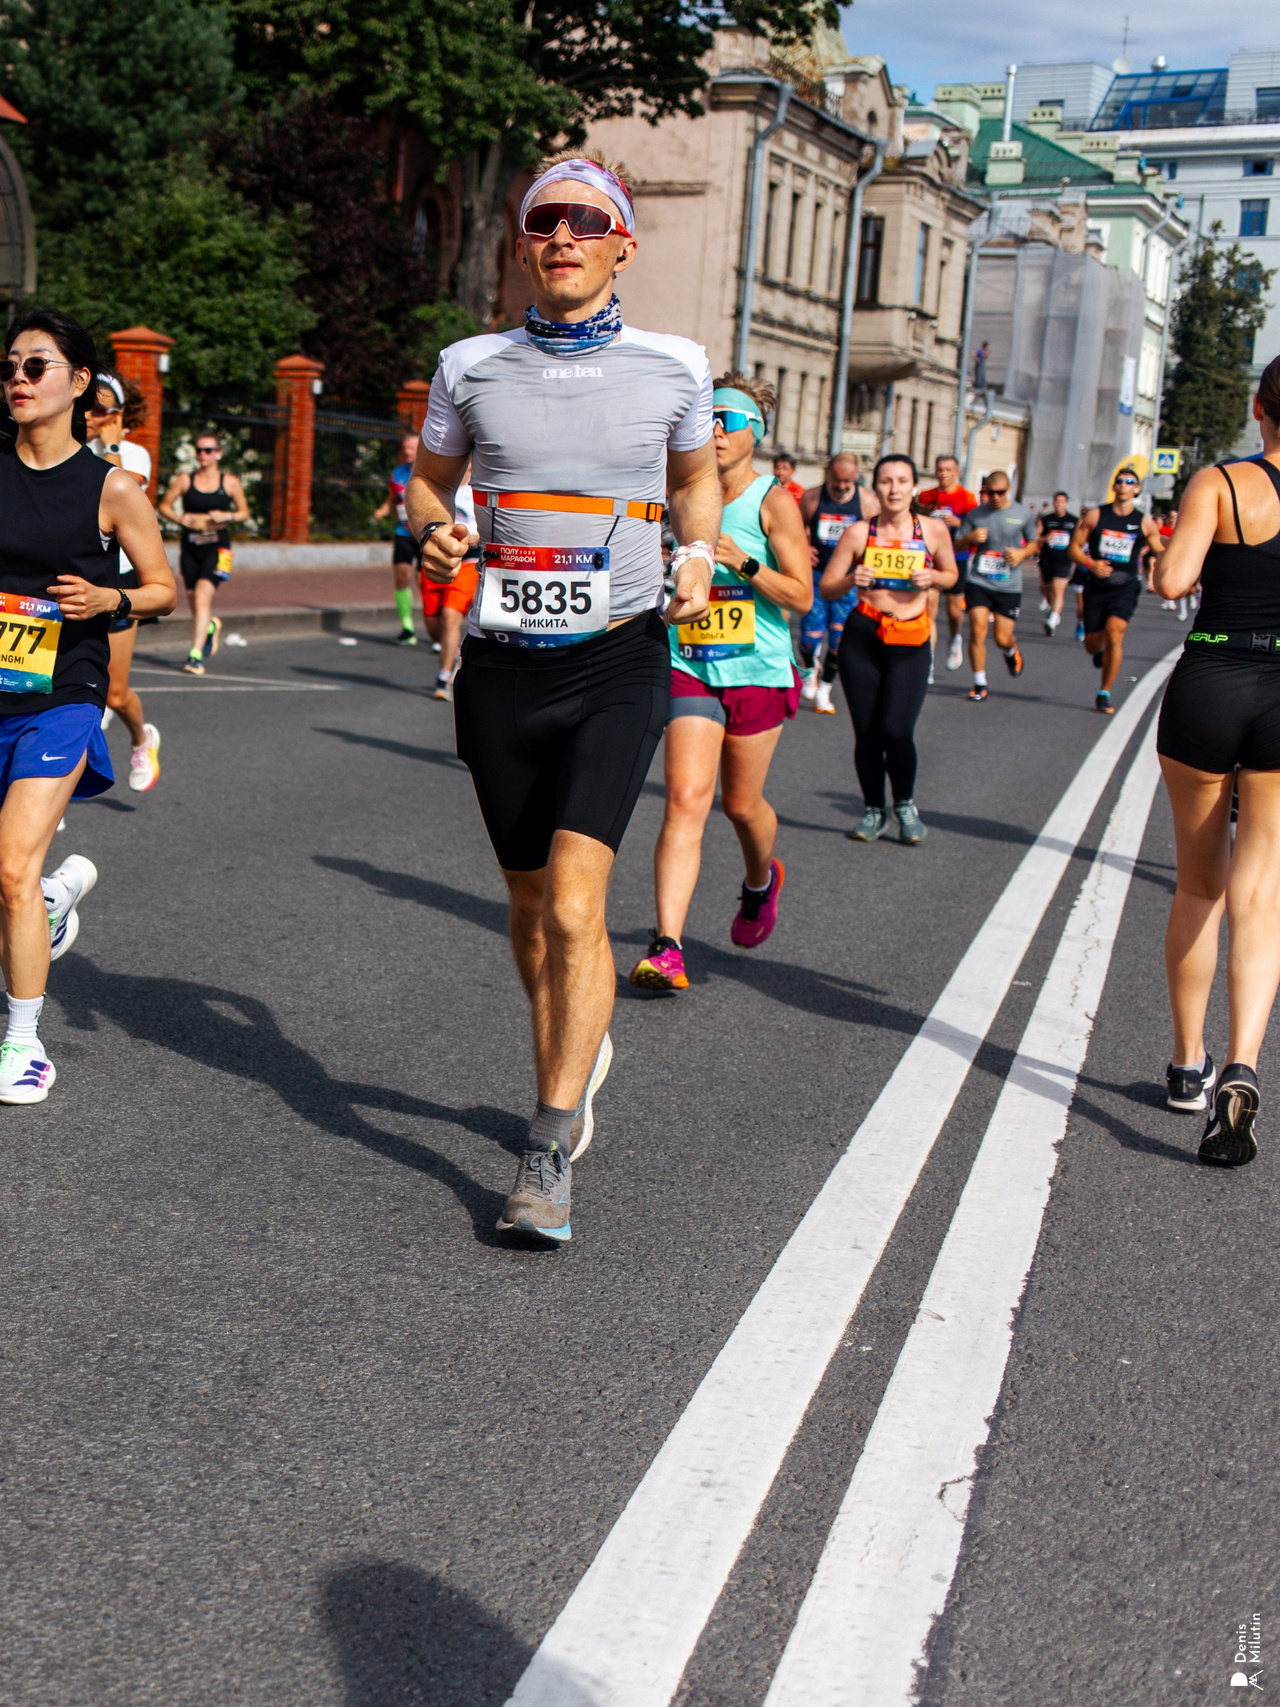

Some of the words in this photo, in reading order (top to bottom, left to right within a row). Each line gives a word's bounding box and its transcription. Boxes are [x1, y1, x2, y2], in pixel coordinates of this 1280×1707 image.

[500, 547, 519, 555] ПОЛУ
[500, 554, 536, 563] МАРАФОН
[554, 554, 573, 565] 21,1
[873, 552, 916, 569] 5187
[500, 578, 592, 615] 5835
[19, 602, 35, 611] 21,1
[520, 618, 568, 628] НИКИТА
